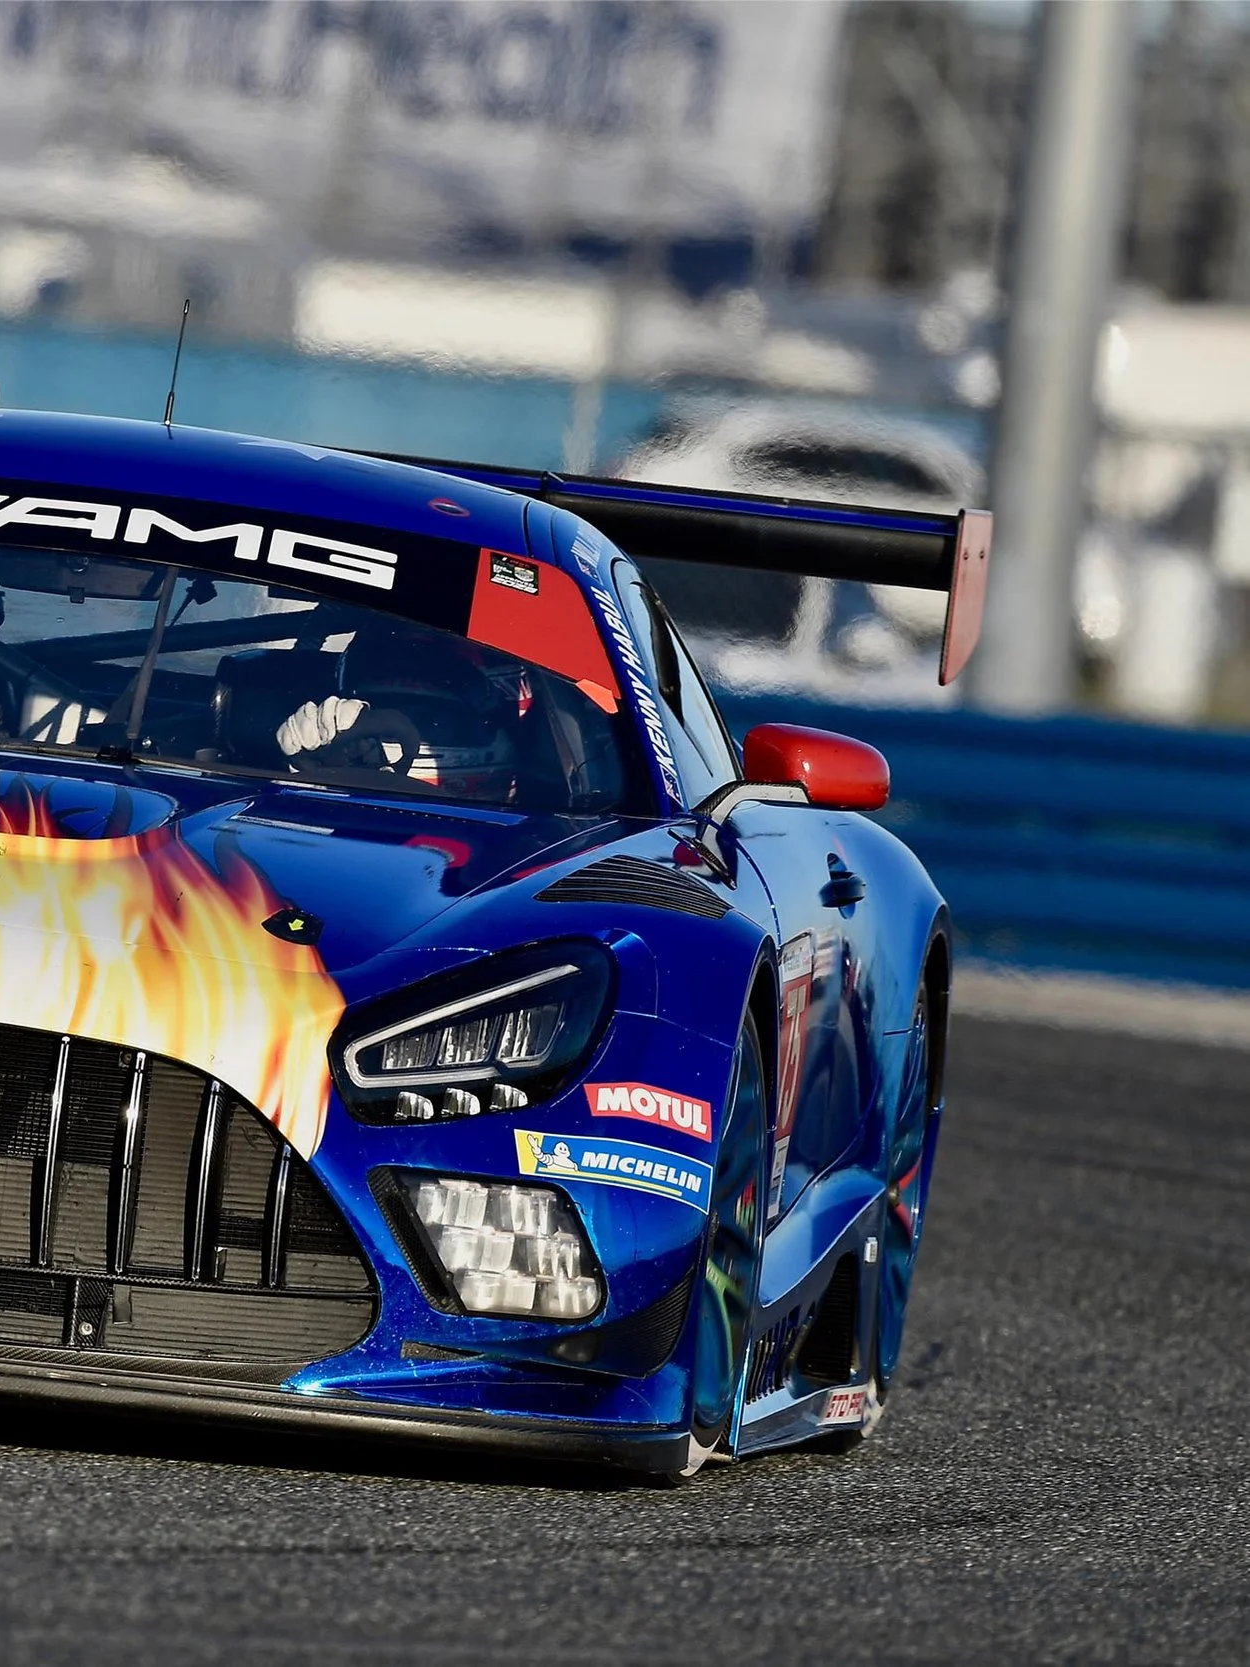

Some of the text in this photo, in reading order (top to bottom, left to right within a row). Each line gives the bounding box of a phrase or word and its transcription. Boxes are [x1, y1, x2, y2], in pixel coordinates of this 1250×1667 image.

[591, 585, 678, 777] KENNY HABUL
[596, 1086, 707, 1135] MOTUL
[581, 1151, 702, 1194] MICHELIN
